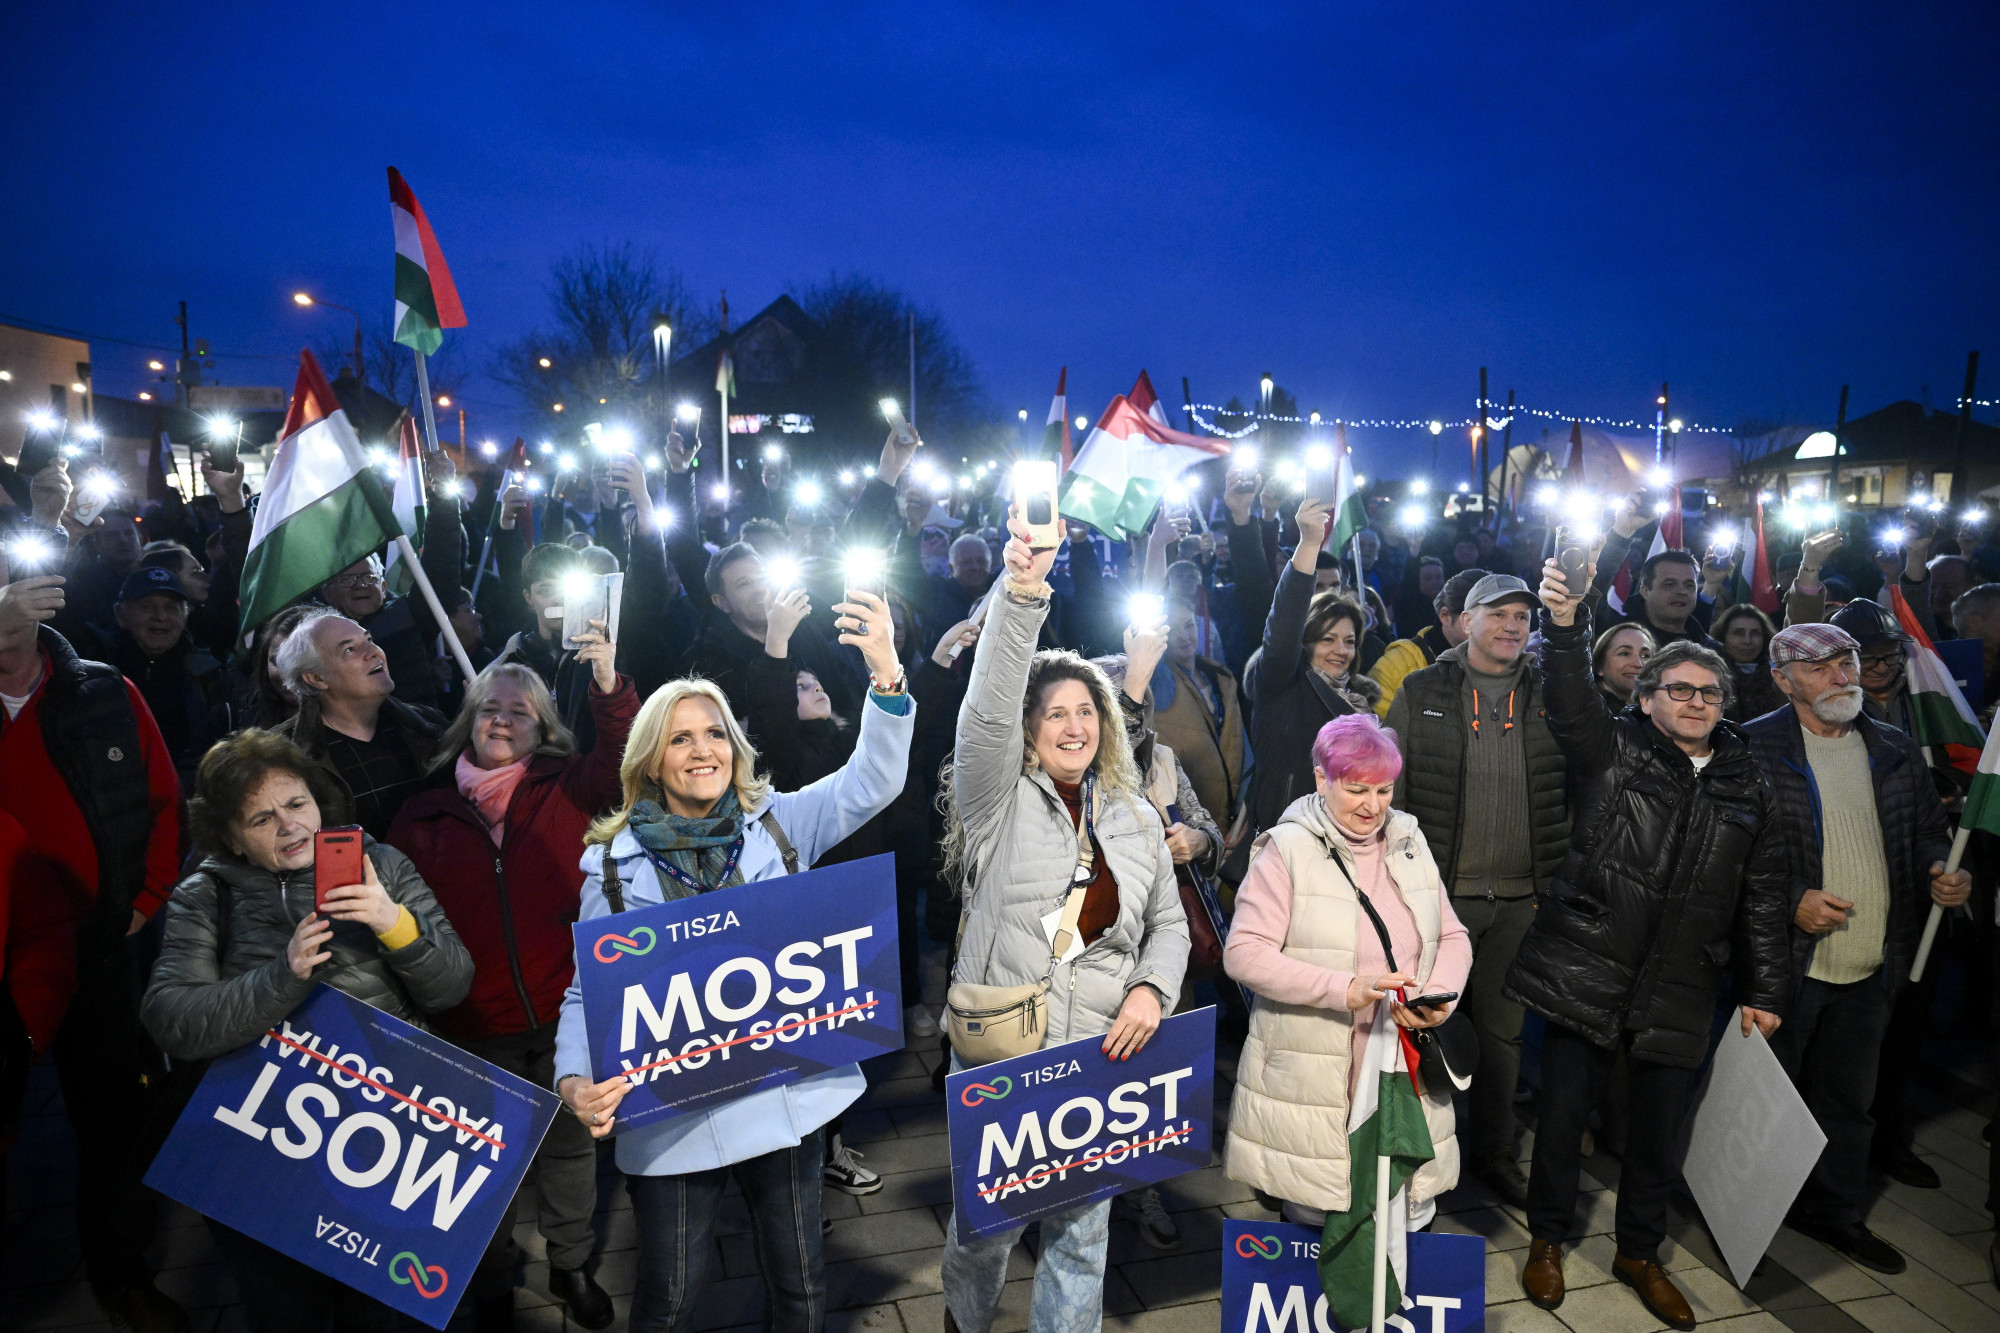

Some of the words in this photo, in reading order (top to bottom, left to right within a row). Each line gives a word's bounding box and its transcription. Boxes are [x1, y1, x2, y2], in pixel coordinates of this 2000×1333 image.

[666, 910, 740, 943] TISZA
[619, 925, 873, 1053] MOST
[620, 1029, 739, 1087] VAGY
[749, 990, 876, 1051] SOHA!
[1020, 1060, 1082, 1088] TISZA
[213, 1061, 492, 1232] MOST
[390, 1084, 503, 1161] VAGY
[977, 1066, 1193, 1178] MOST
[977, 1155, 1073, 1204] VAGY
[1083, 1120, 1190, 1173] SOHA!
[314, 1215, 382, 1266] TISZA
